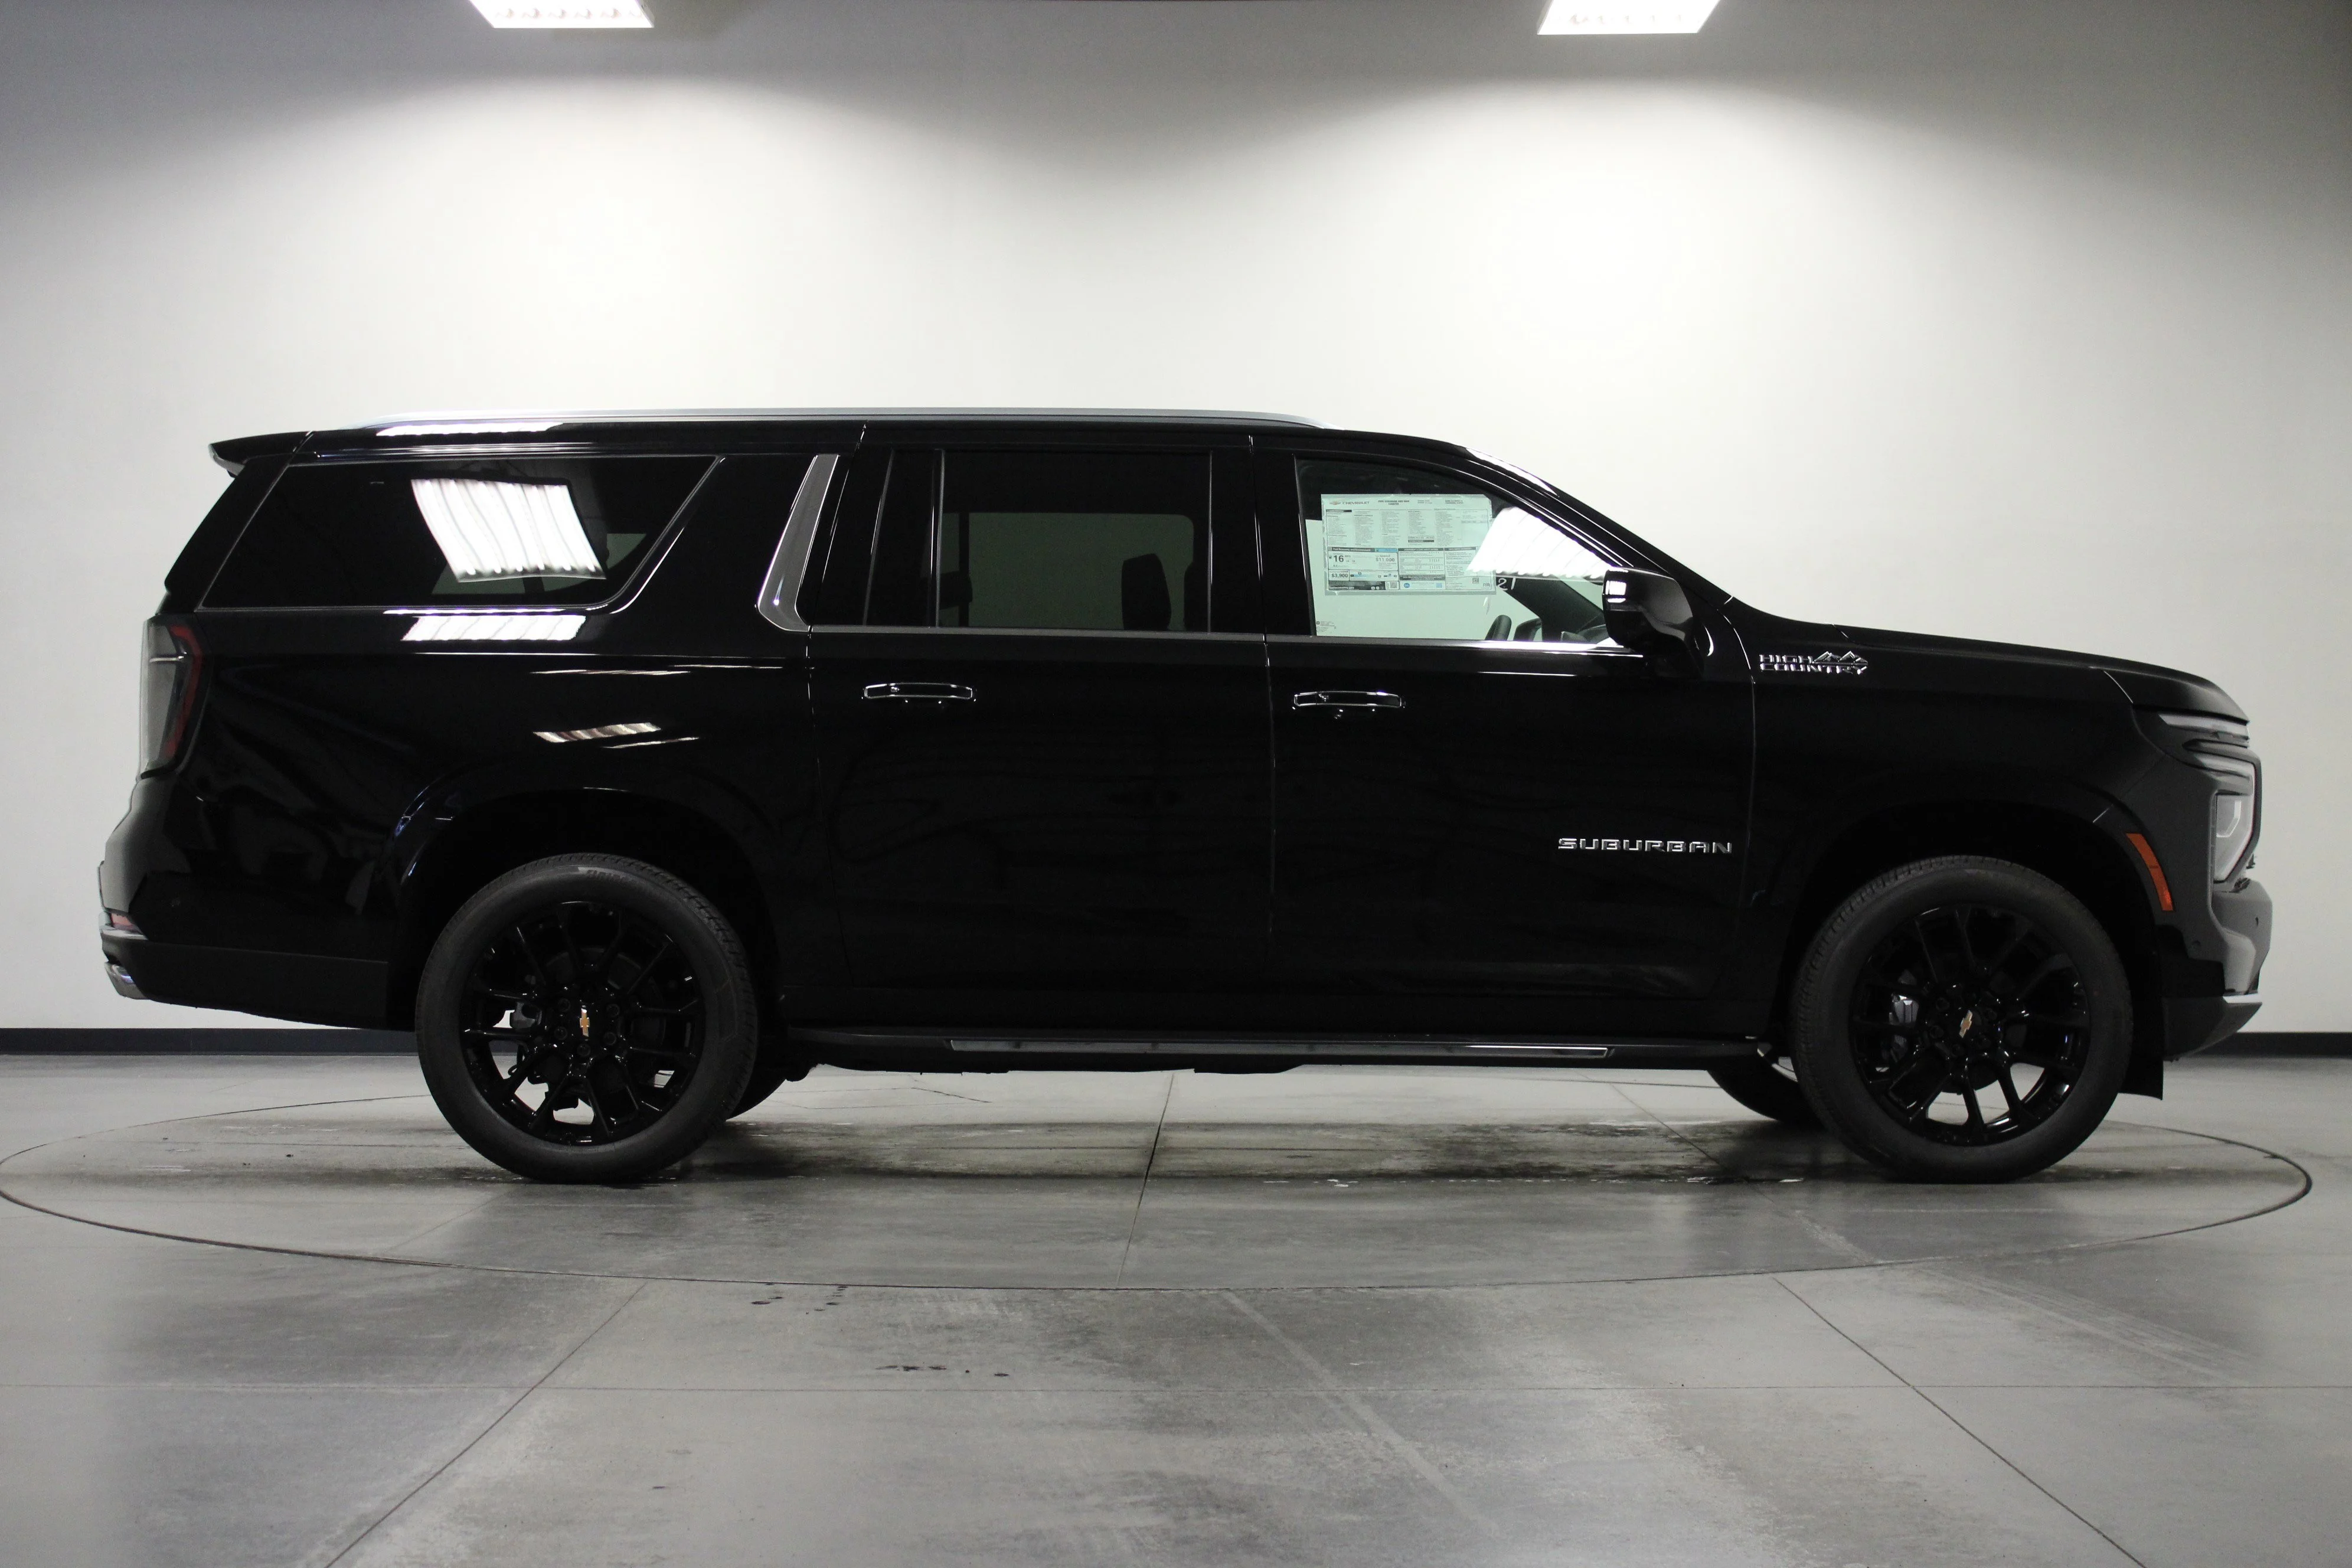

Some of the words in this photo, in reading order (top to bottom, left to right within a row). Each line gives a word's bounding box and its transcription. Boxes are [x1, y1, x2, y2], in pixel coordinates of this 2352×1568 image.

[1759, 654, 1813, 664] HIGH
[1760, 663, 1867, 675] COUNTRY
[1558, 838, 1732, 853] SUBURBAN
